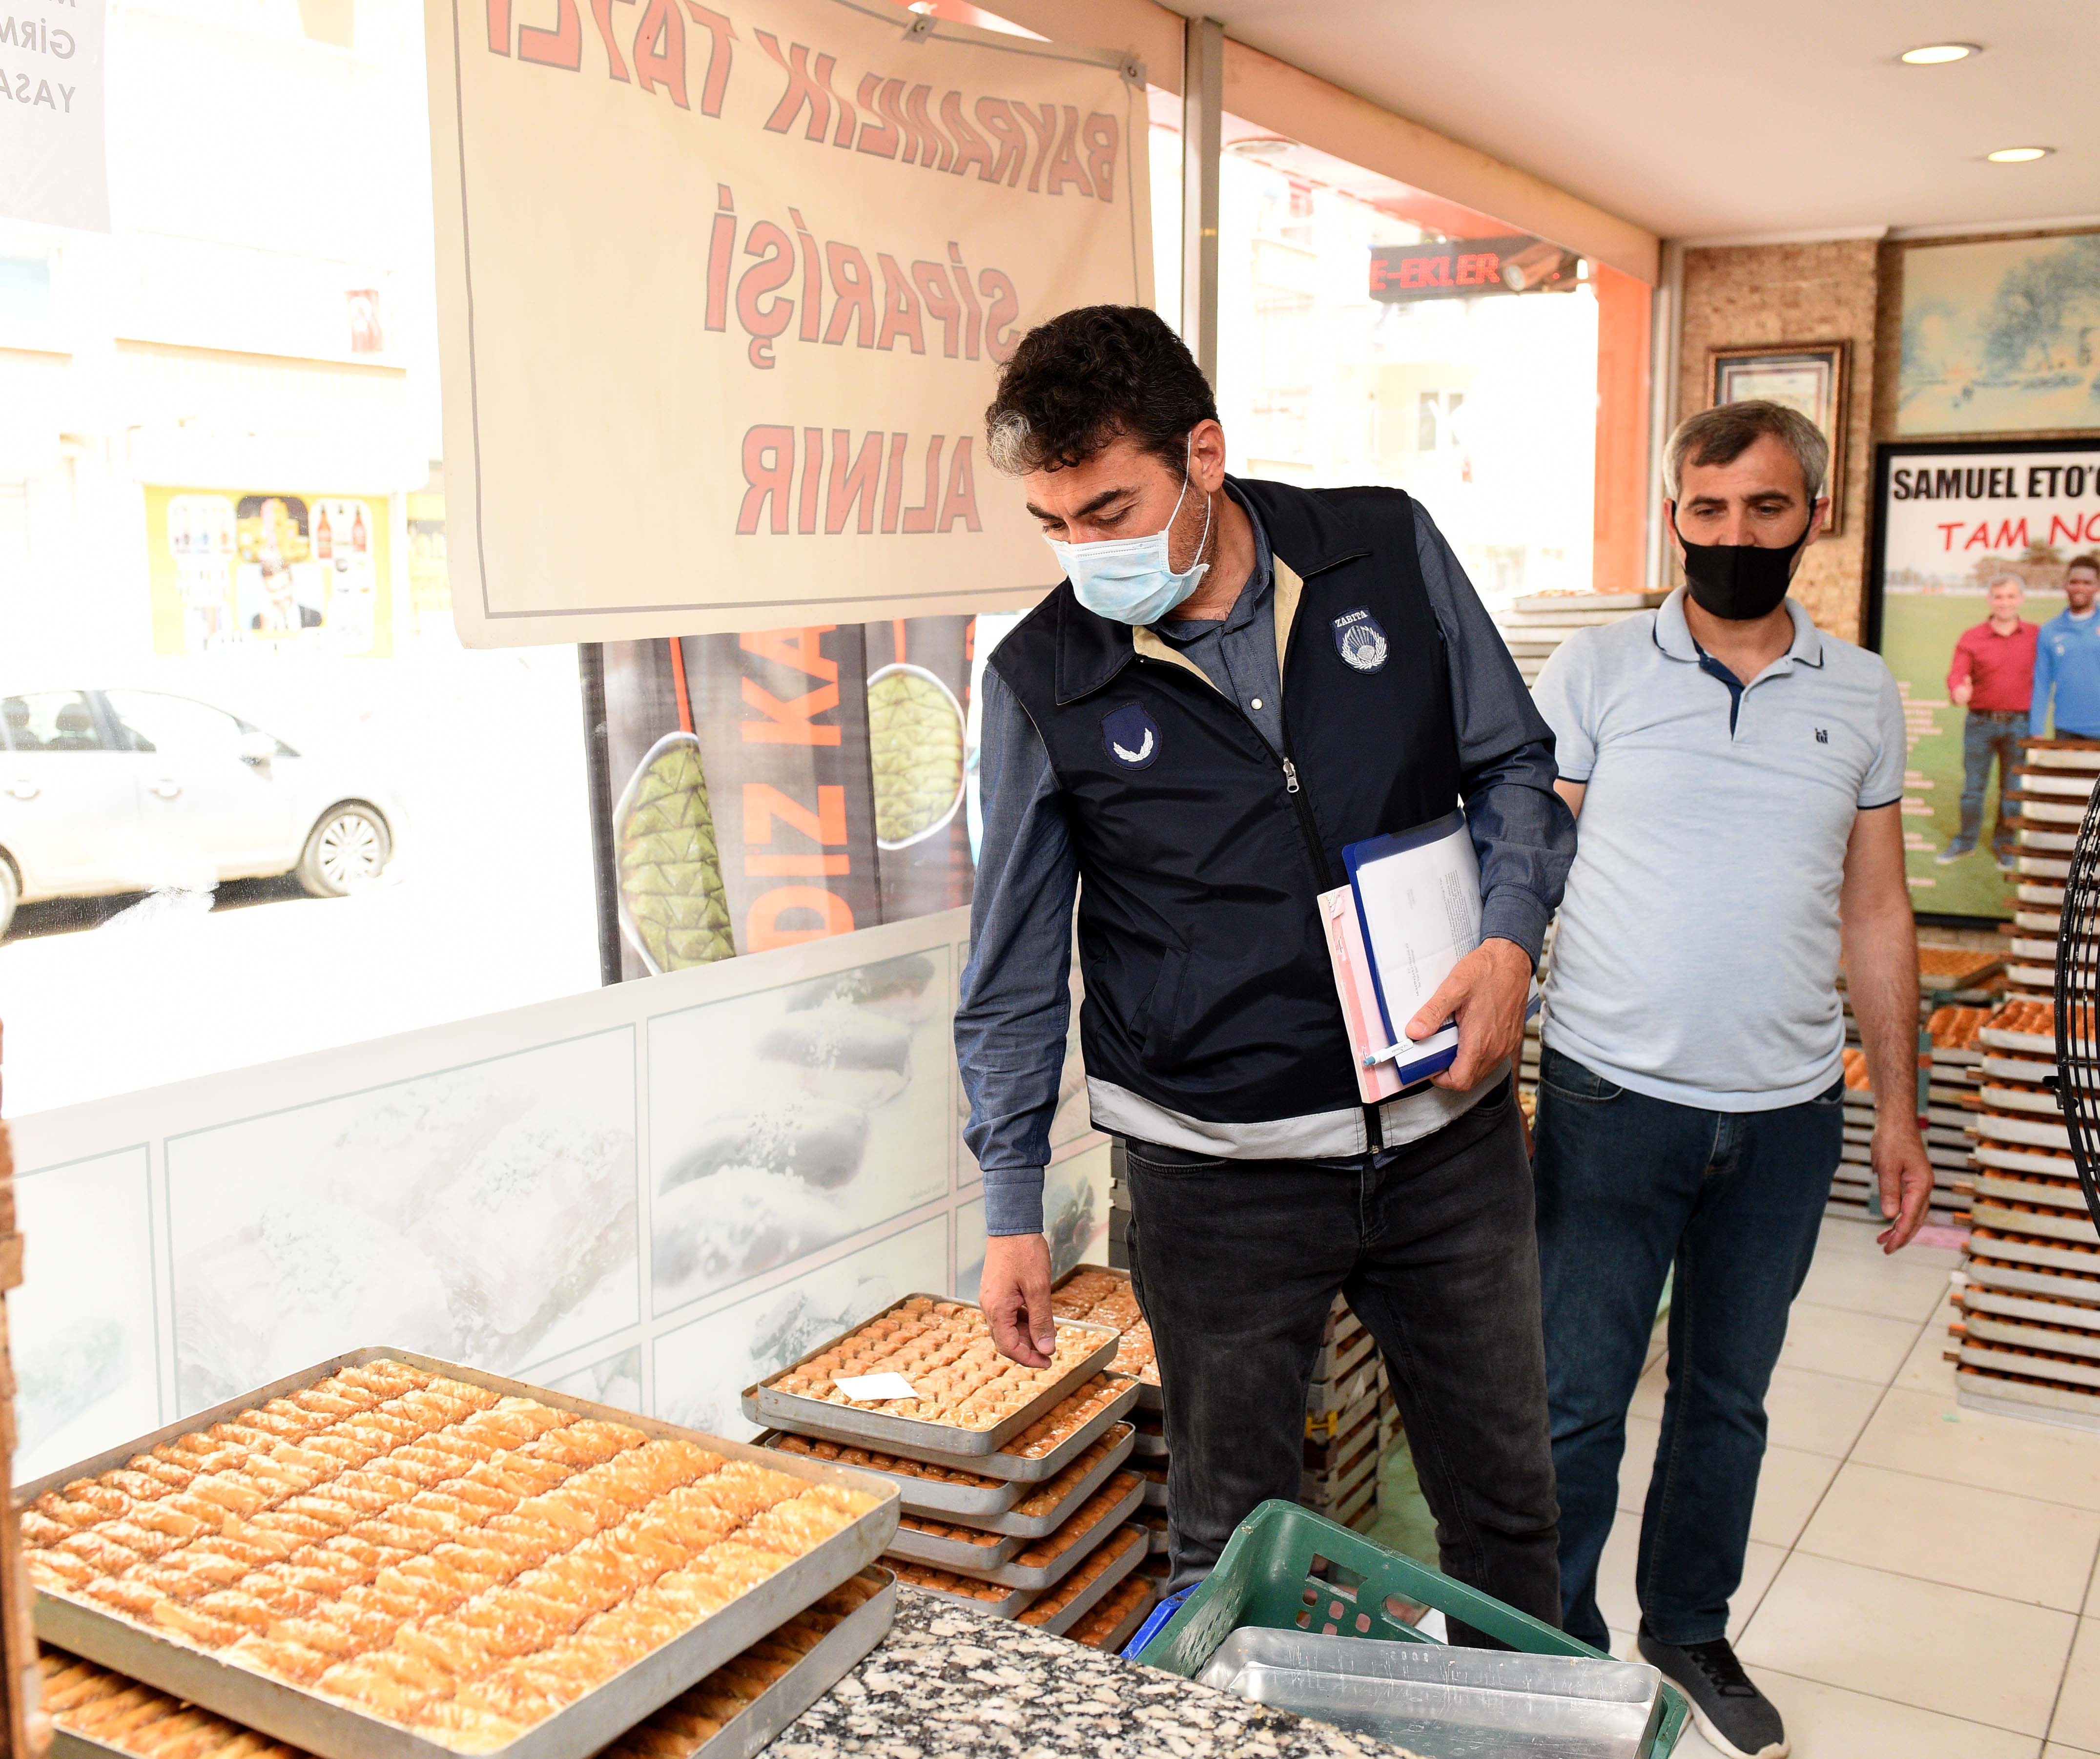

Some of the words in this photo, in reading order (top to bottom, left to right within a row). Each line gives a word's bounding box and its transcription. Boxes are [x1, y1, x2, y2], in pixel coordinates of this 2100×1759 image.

[1893, 467, 2019, 500] SAMUEL
[2027, 465, 2100, 498] ETO'
[1937, 517, 2029, 552] TAM
[1335, 610, 1368, 628] ZABITA
